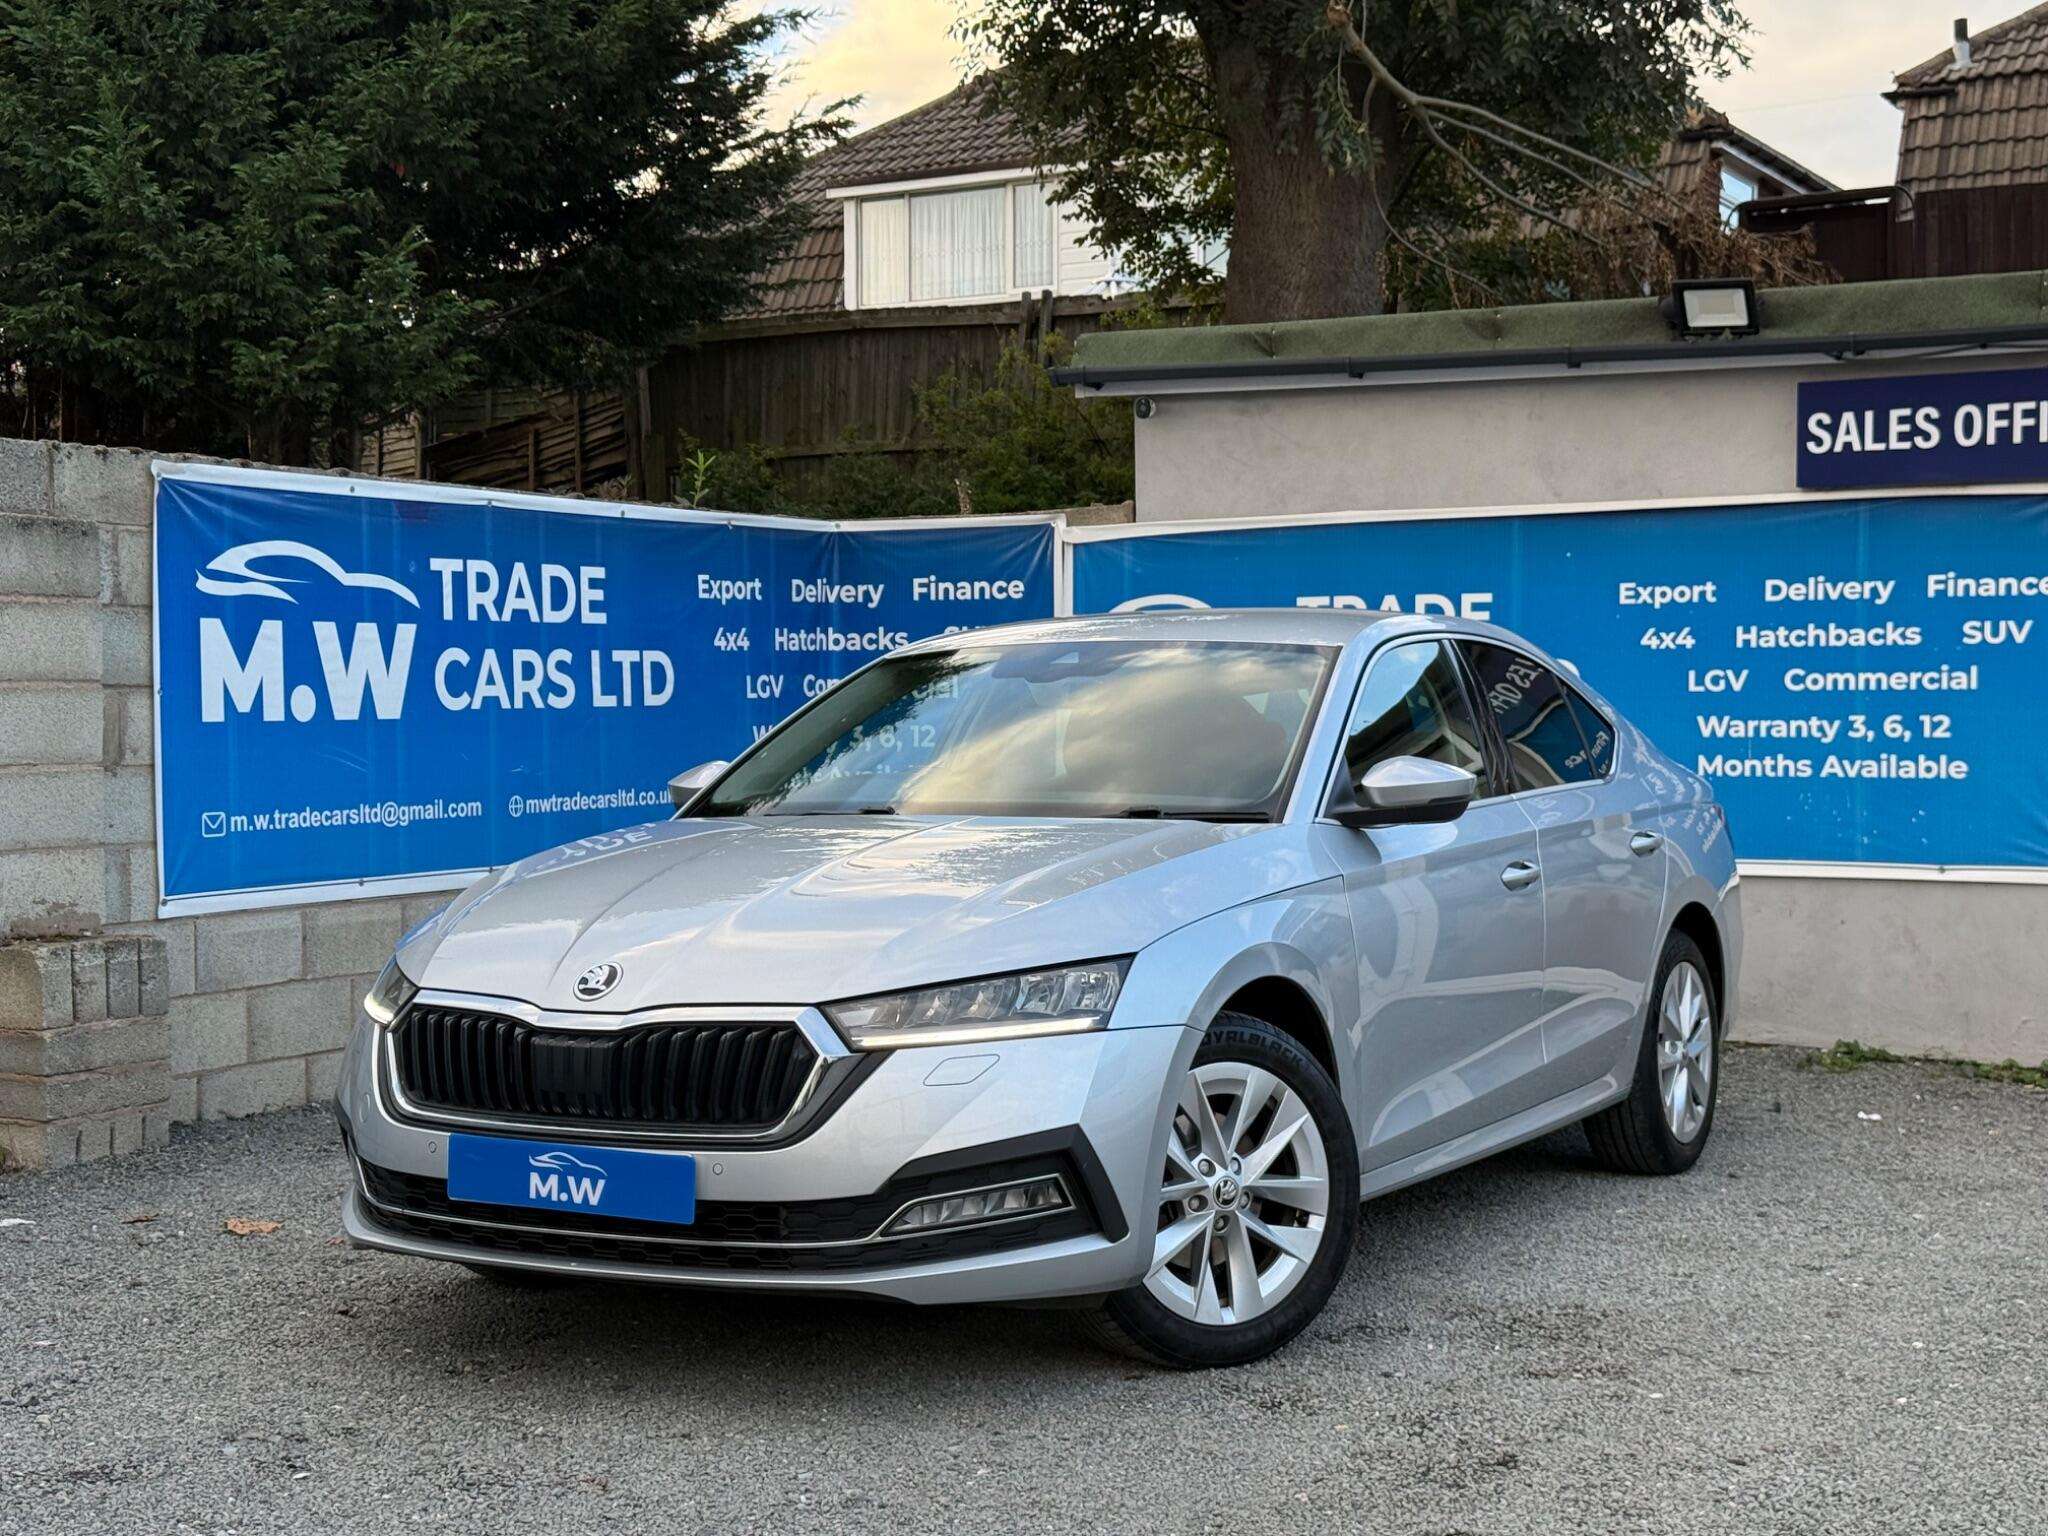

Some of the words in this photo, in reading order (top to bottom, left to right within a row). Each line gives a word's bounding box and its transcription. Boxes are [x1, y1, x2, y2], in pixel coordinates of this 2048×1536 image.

[1806, 406, 1941, 455] SALES
[429, 557, 607, 625] TRADE
[697, 573, 762, 606] Export
[791, 577, 885, 609] Delivery
[912, 575, 1025, 601] Finance
[1619, 580, 1717, 609] Export
[1764, 575, 1896, 605] Delivery
[713, 627, 750, 651] 4x4
[774, 626, 909, 651] Hatchbacks
[1640, 627, 1696, 650] 4x4
[1735, 621, 1922, 649] Hatchbacks
[1962, 619, 2034, 645] SUV
[199, 617, 417, 723] M.W
[434, 647, 577, 711] CARS
[590, 649, 676, 708] LTD
[746, 673, 784, 699] LGV
[1688, 668, 1749, 693] LGV
[1783, 664, 1979, 692] Commercial
[1697, 714, 1841, 744] Warranty
[1847, 713, 1875, 742] 3,
[1883, 713, 1912, 742] 6,
[1919, 713, 1952, 739] 12
[1696, 752, 1813, 780] Months
[1819, 753, 1970, 780] Available
[230, 799, 483, 832] m.w.tradecarsltd@gmail.com
[529, 1170, 606, 1207] M.W
